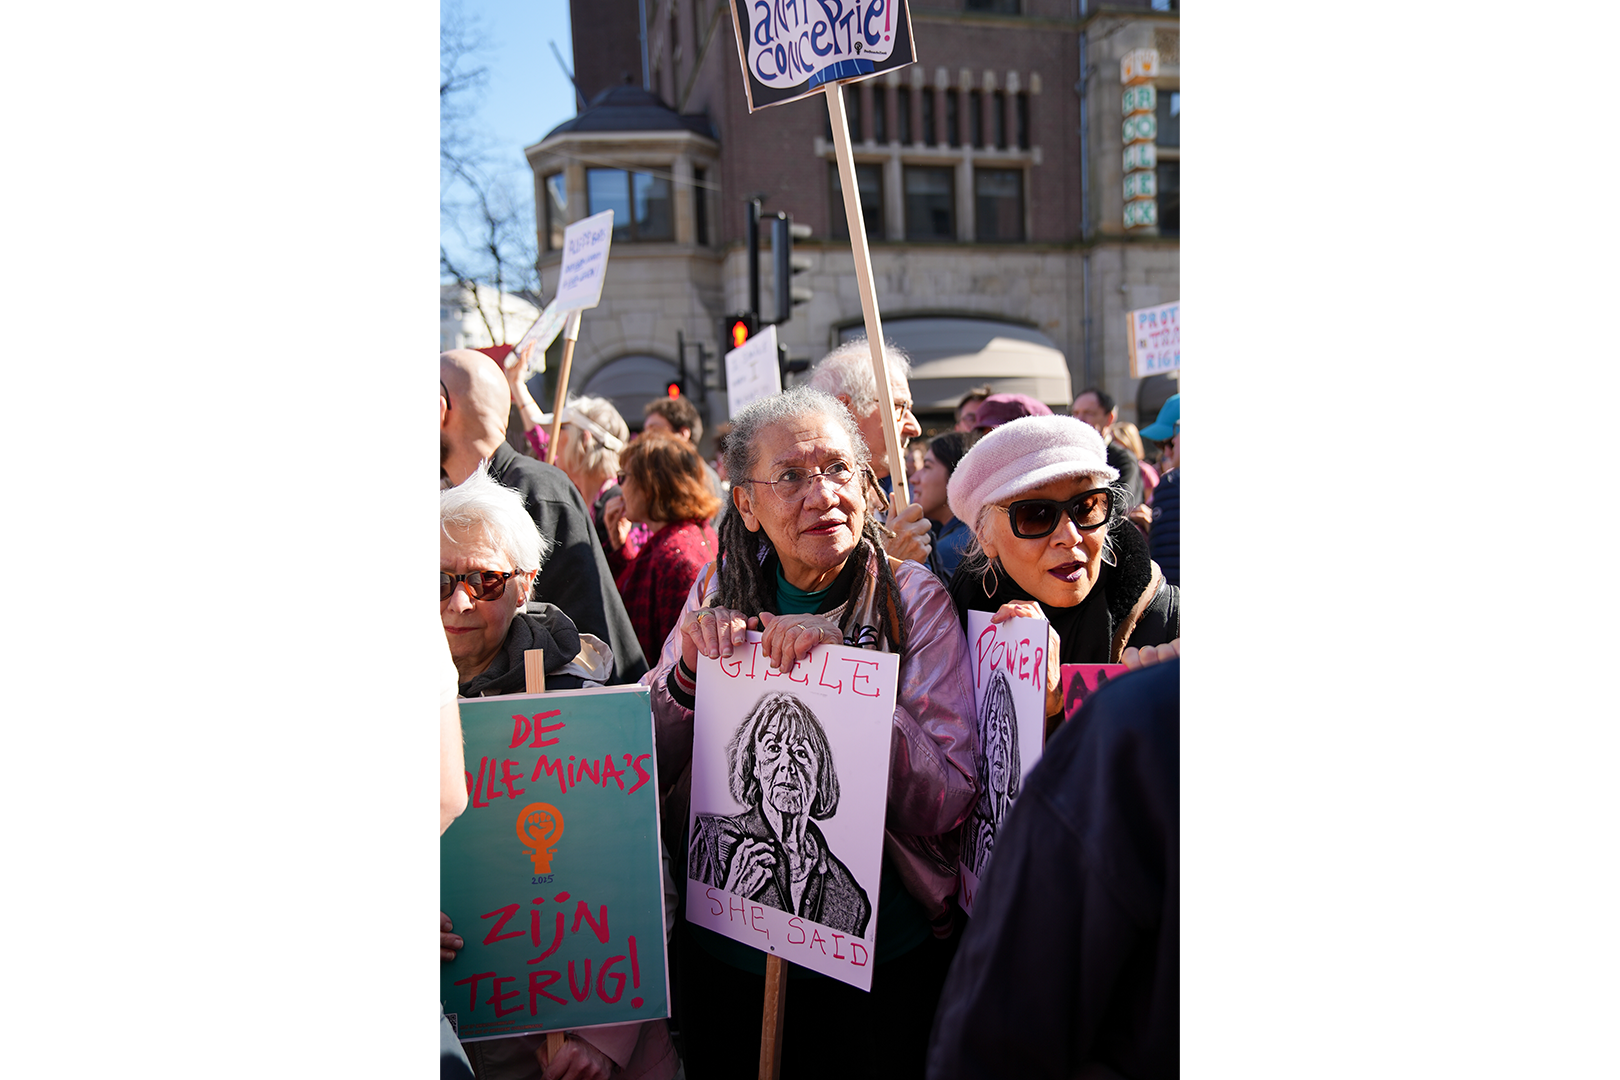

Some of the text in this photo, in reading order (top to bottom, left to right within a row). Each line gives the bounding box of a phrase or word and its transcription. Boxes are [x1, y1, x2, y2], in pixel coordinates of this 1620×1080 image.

[975, 624, 1043, 691] POWER
[508, 708, 566, 749] DE
[787, 917, 869, 967] SAID
[454, 935, 644, 1018] TERUG!
